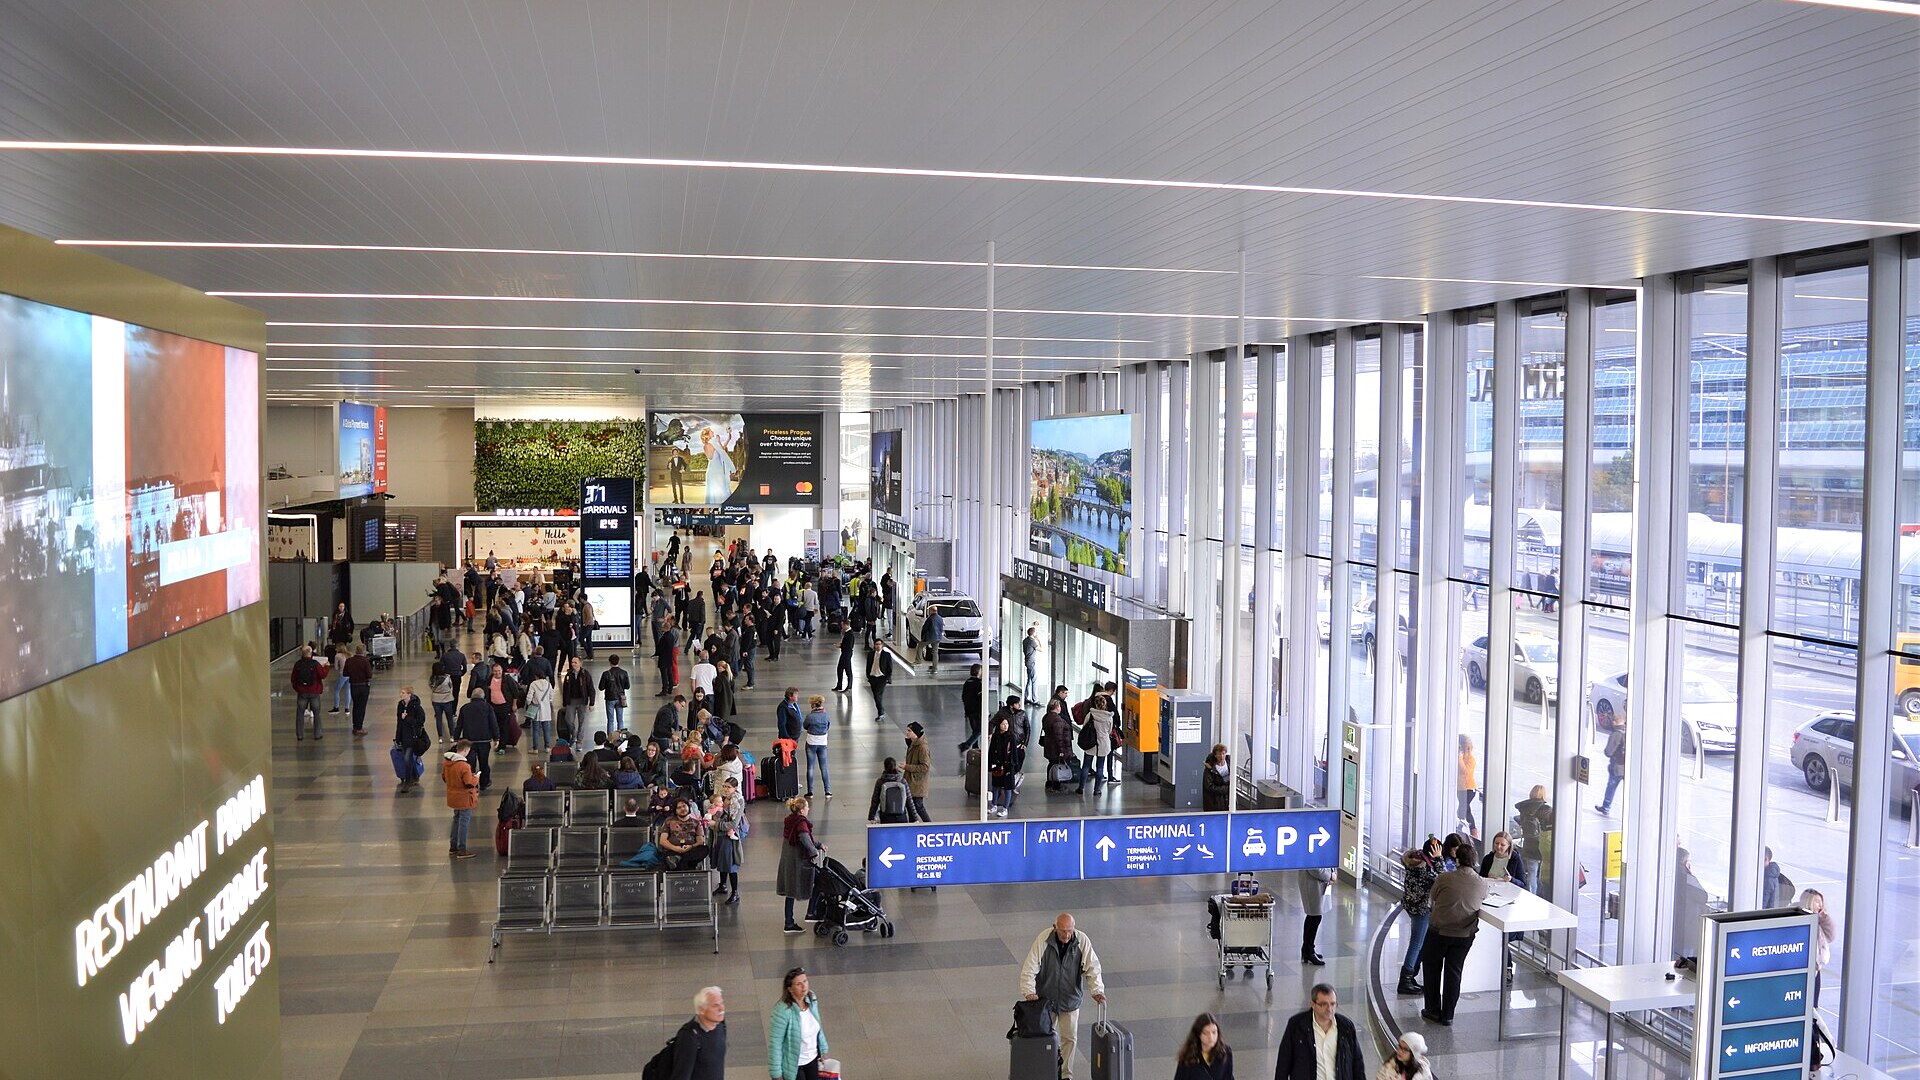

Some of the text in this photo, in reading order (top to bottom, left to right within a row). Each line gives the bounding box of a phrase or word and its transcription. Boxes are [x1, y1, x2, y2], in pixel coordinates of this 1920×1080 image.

[496, 508, 555, 516] MATTONI
[588, 505, 628, 514] ARRIVALS
[544, 529, 567, 539] Hello
[1018, 561, 1029, 580] EXIT
[916, 830, 1011, 848] RESTAURANT
[1038, 828, 1068, 843] ATM
[1126, 823, 1205, 840] TERMINAL 1
[1276, 826, 1298, 855] P
[916, 855, 953, 863] RESTAURACE
[75, 819, 209, 986] RESTAURANT
[1751, 942, 1805, 957] RESTAURANT
[214, 920, 271, 1024] TOILETS
[1784, 990, 1802, 1002] ATM
[1744, 1037, 1799, 1054] INFORMATION
